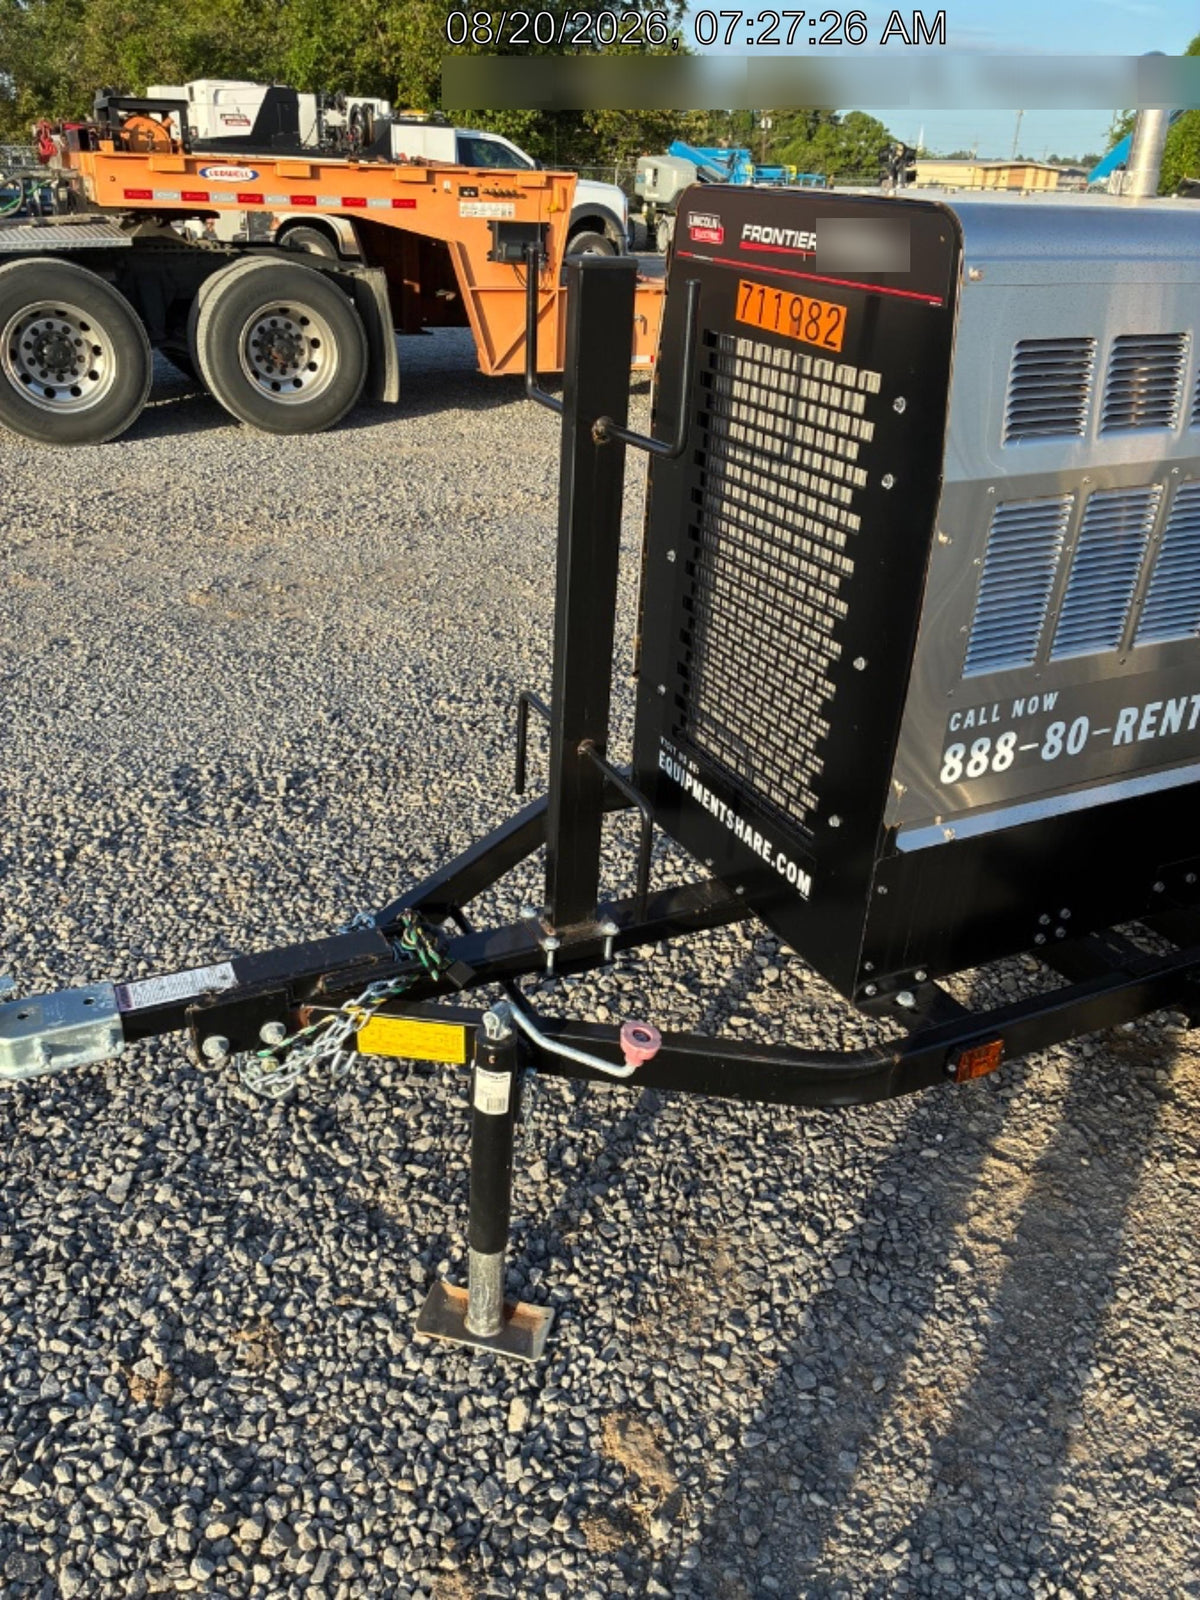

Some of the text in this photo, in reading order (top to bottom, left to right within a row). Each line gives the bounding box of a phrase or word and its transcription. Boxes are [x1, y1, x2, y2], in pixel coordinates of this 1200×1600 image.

[741, 224, 816, 251] FRONTIER
[740, 284, 841, 348] 711982
[949, 691, 1059, 732] CALL NOW
[658, 749, 812, 898] EQUIPMENTSHARE.COM
